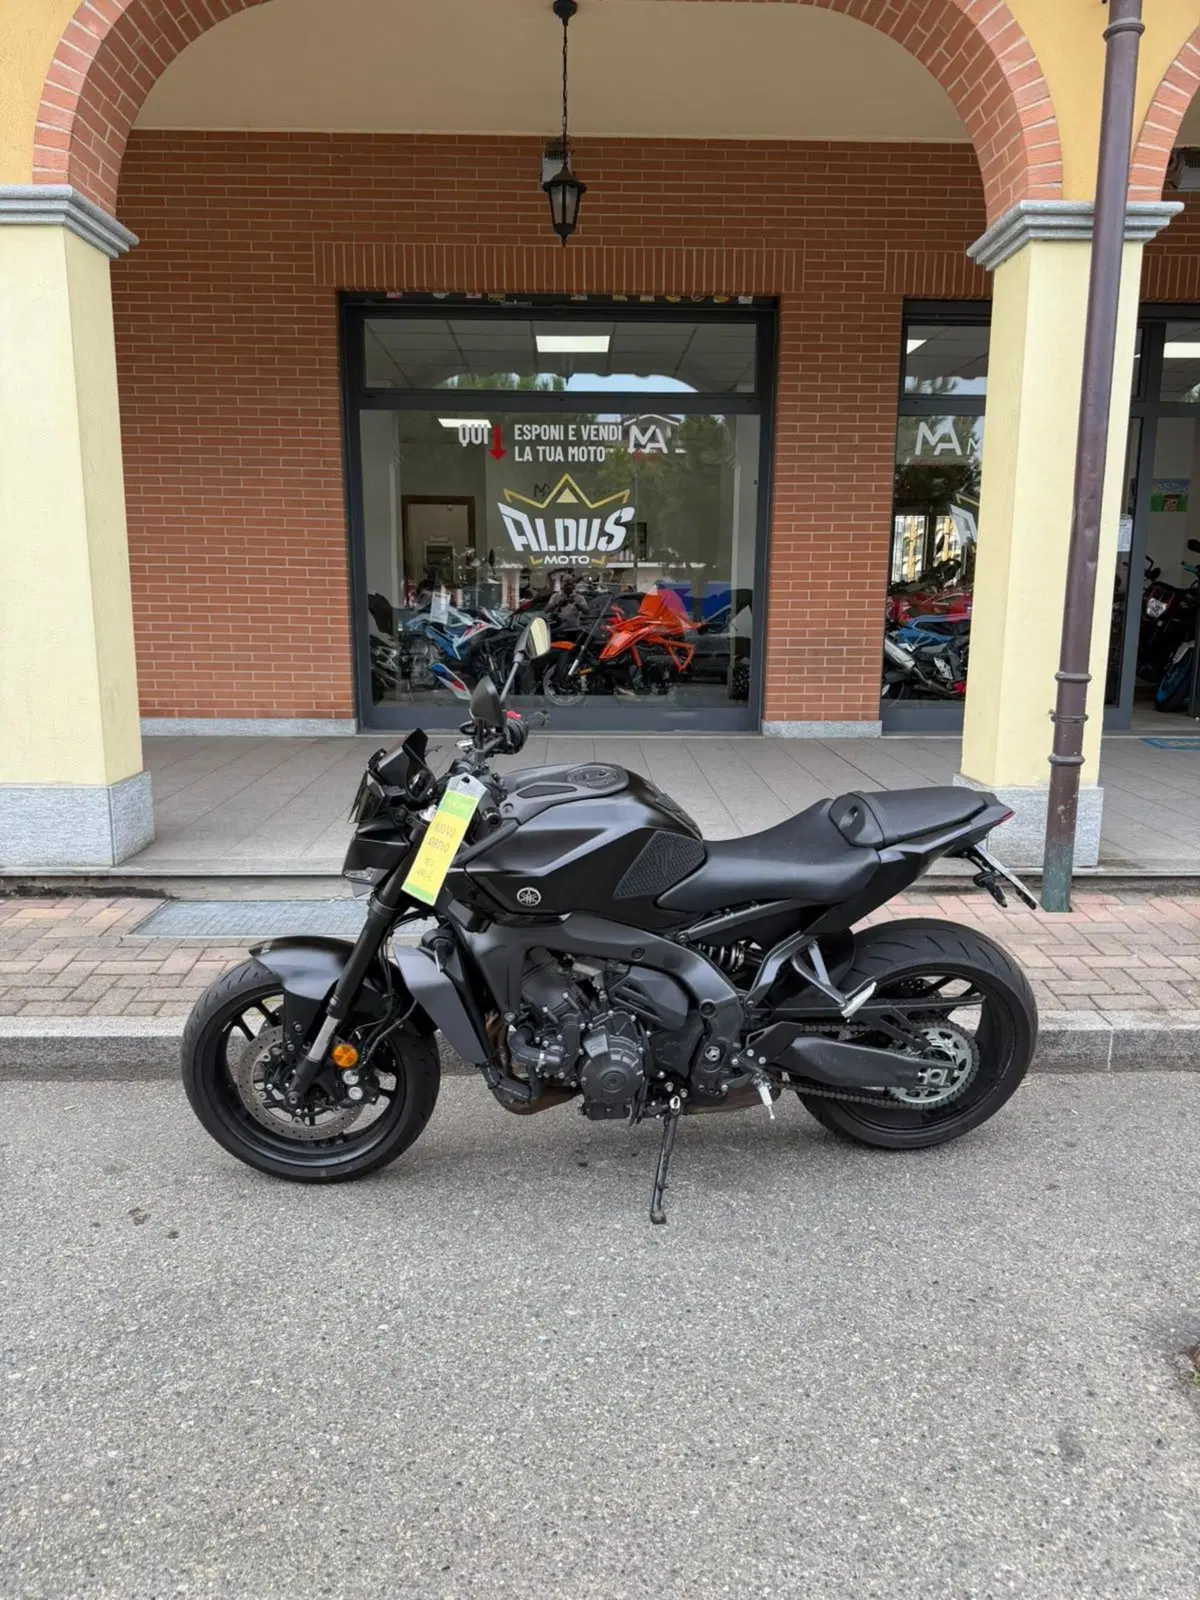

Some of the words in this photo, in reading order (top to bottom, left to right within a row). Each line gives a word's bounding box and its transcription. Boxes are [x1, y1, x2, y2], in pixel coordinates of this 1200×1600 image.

[458, 424, 489, 447] QUI
[514, 424, 564, 441] ESPONI
[569, 424, 576, 441] E
[581, 424, 622, 441] VENDI
[514, 446, 532, 462] LA
[538, 446, 564, 462] TUA
[568, 446, 605, 462] MOTO
[497, 502, 635, 552] ALDUS
[544, 555, 590, 565] MOTO
